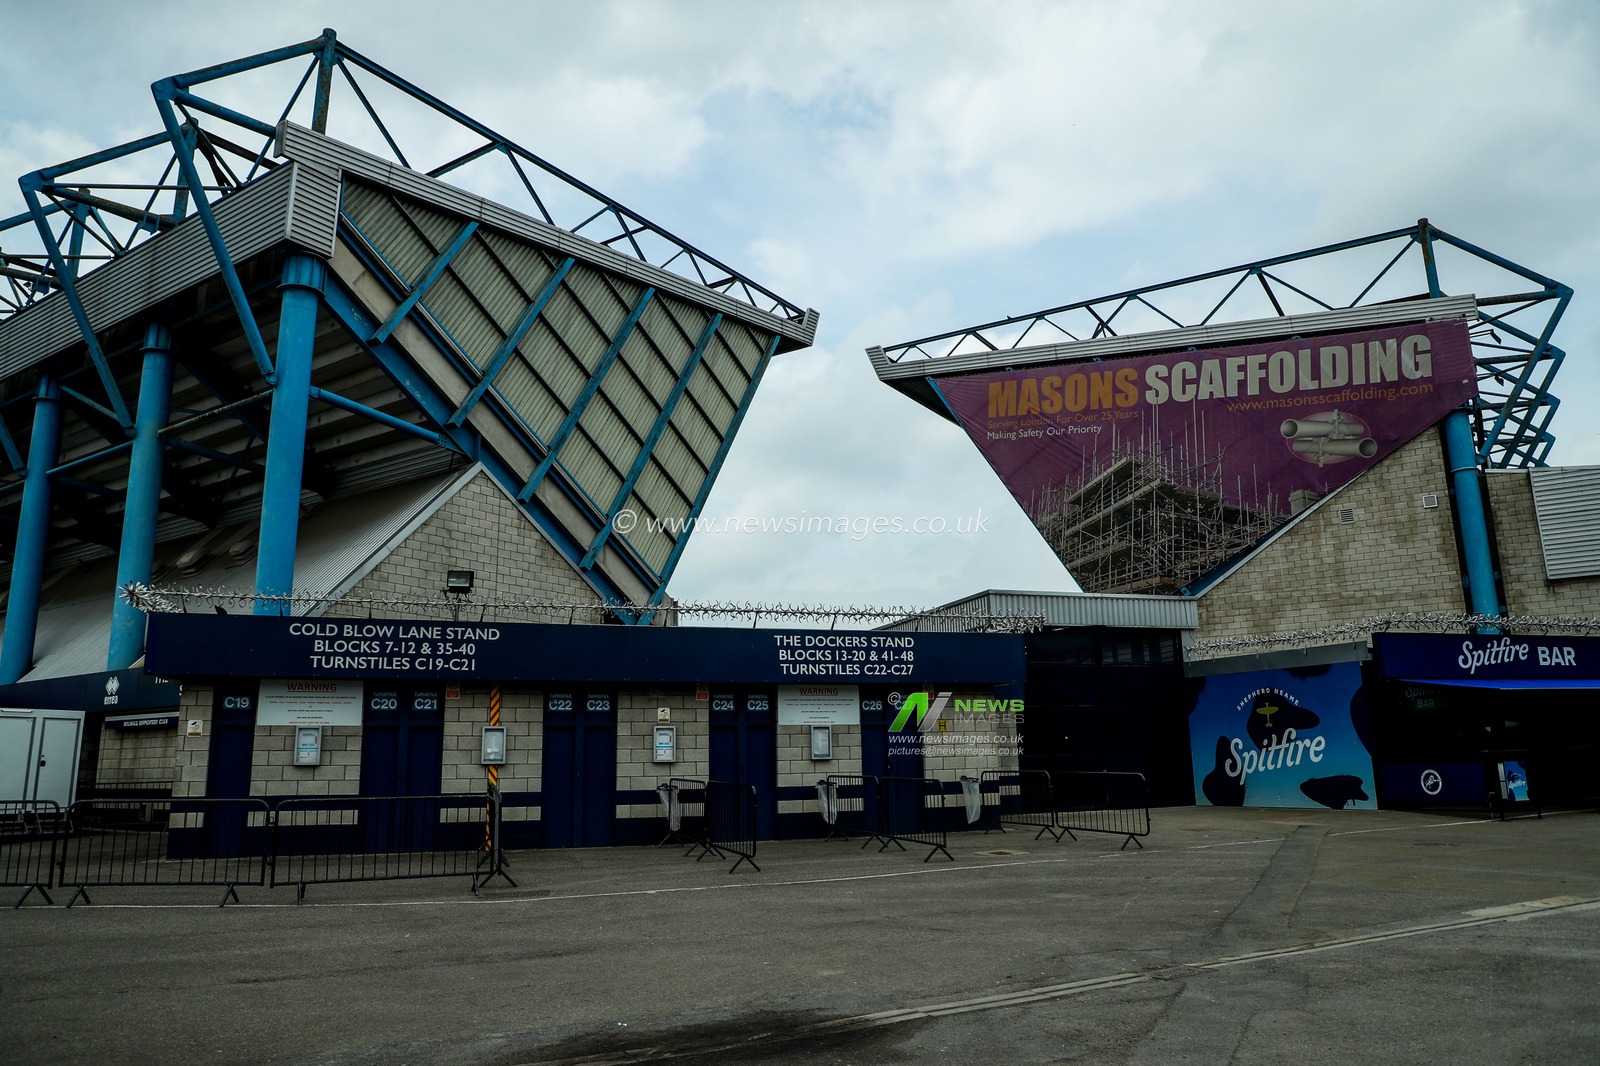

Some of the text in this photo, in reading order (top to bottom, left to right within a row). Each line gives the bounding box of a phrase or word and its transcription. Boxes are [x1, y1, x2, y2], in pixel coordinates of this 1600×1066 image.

[988, 334, 1433, 418] MASONS SCAFFOLDING
[1226, 383, 1433, 412] www.masonsscaffolding.com
[988, 410, 1139, 429] Serving London For Over 25 Years
[987, 424, 1103, 441] Making Safety Our Priority
[289, 623, 500, 641] COLD BLOW LANE STAND
[314, 639, 476, 656] BLOCKS 7-12 & 35-40
[774, 635, 915, 648] THE DOCKERS STAND
[779, 649, 914, 662] BLOCKS 13-20 & 41-48
[1458, 636, 1577, 675] Spitfire BAR
[310, 655, 476, 671] TURNSTILES C19-C21
[780, 663, 914, 675] TURNSTILES C22-C27
[287, 683, 337, 692] WARNING
[799, 687, 839, 696] WARNING
[224, 696, 250, 708] C19
[370, 698, 398, 709] C20
[414, 698, 438, 709] C21
[548, 700, 573, 711] C22
[586, 700, 610, 711] C23
[712, 700, 735, 710] C24
[747, 700, 769, 710] C25
[862, 700, 883, 710] C26
[1236, 687, 1300, 712] SHEPHERD NEAME
[1416, 698, 1435, 708] BAR
[1224, 727, 1326, 786] Spitfire
